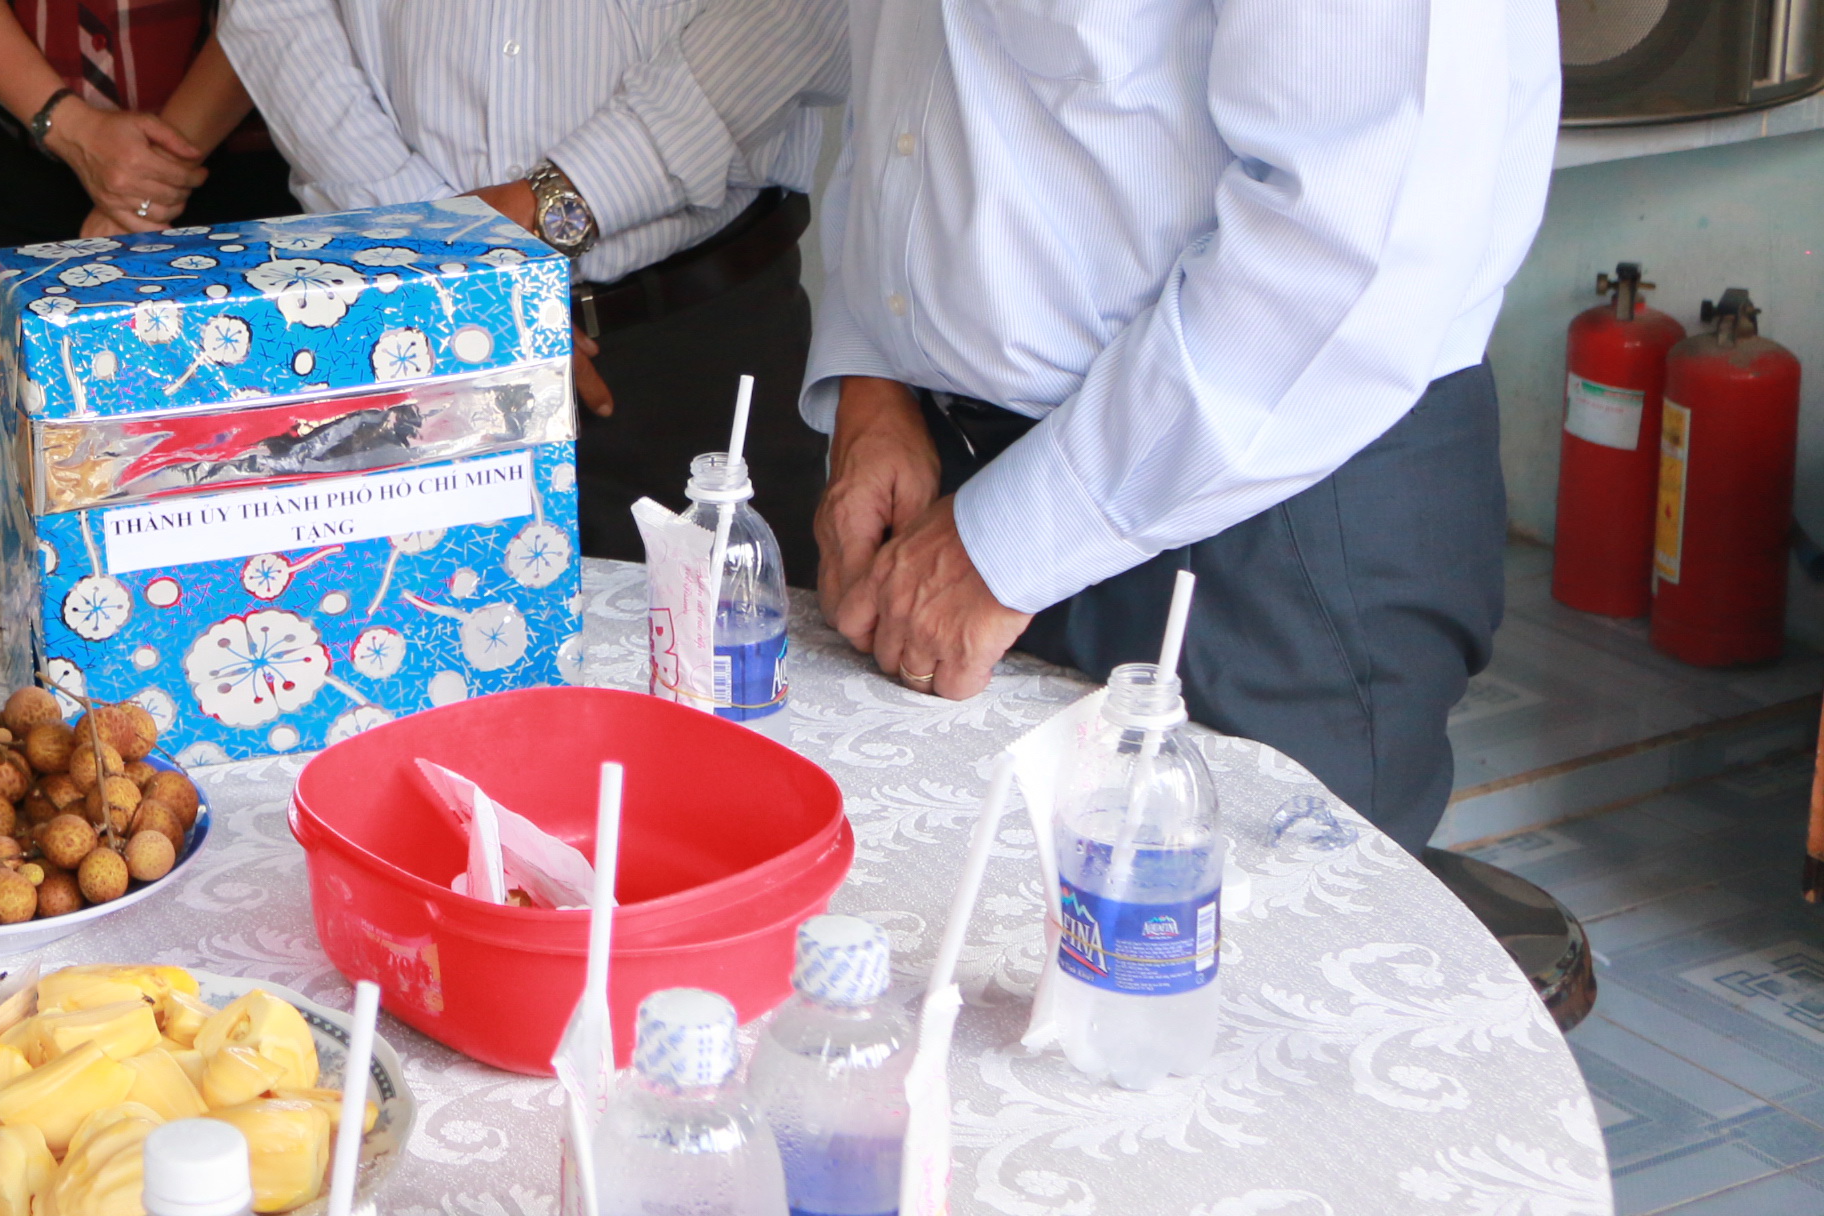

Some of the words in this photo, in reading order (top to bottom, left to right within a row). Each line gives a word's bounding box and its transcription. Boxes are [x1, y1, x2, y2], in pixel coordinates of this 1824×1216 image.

[110, 511, 192, 536] THÀNH
[201, 504, 232, 525] ỦY
[237, 491, 319, 520] THÀNH
[327, 482, 373, 509] PHỐ
[380, 477, 412, 501] HỒ
[418, 470, 458, 495] CHÍ
[465, 464, 524, 488] MINH
